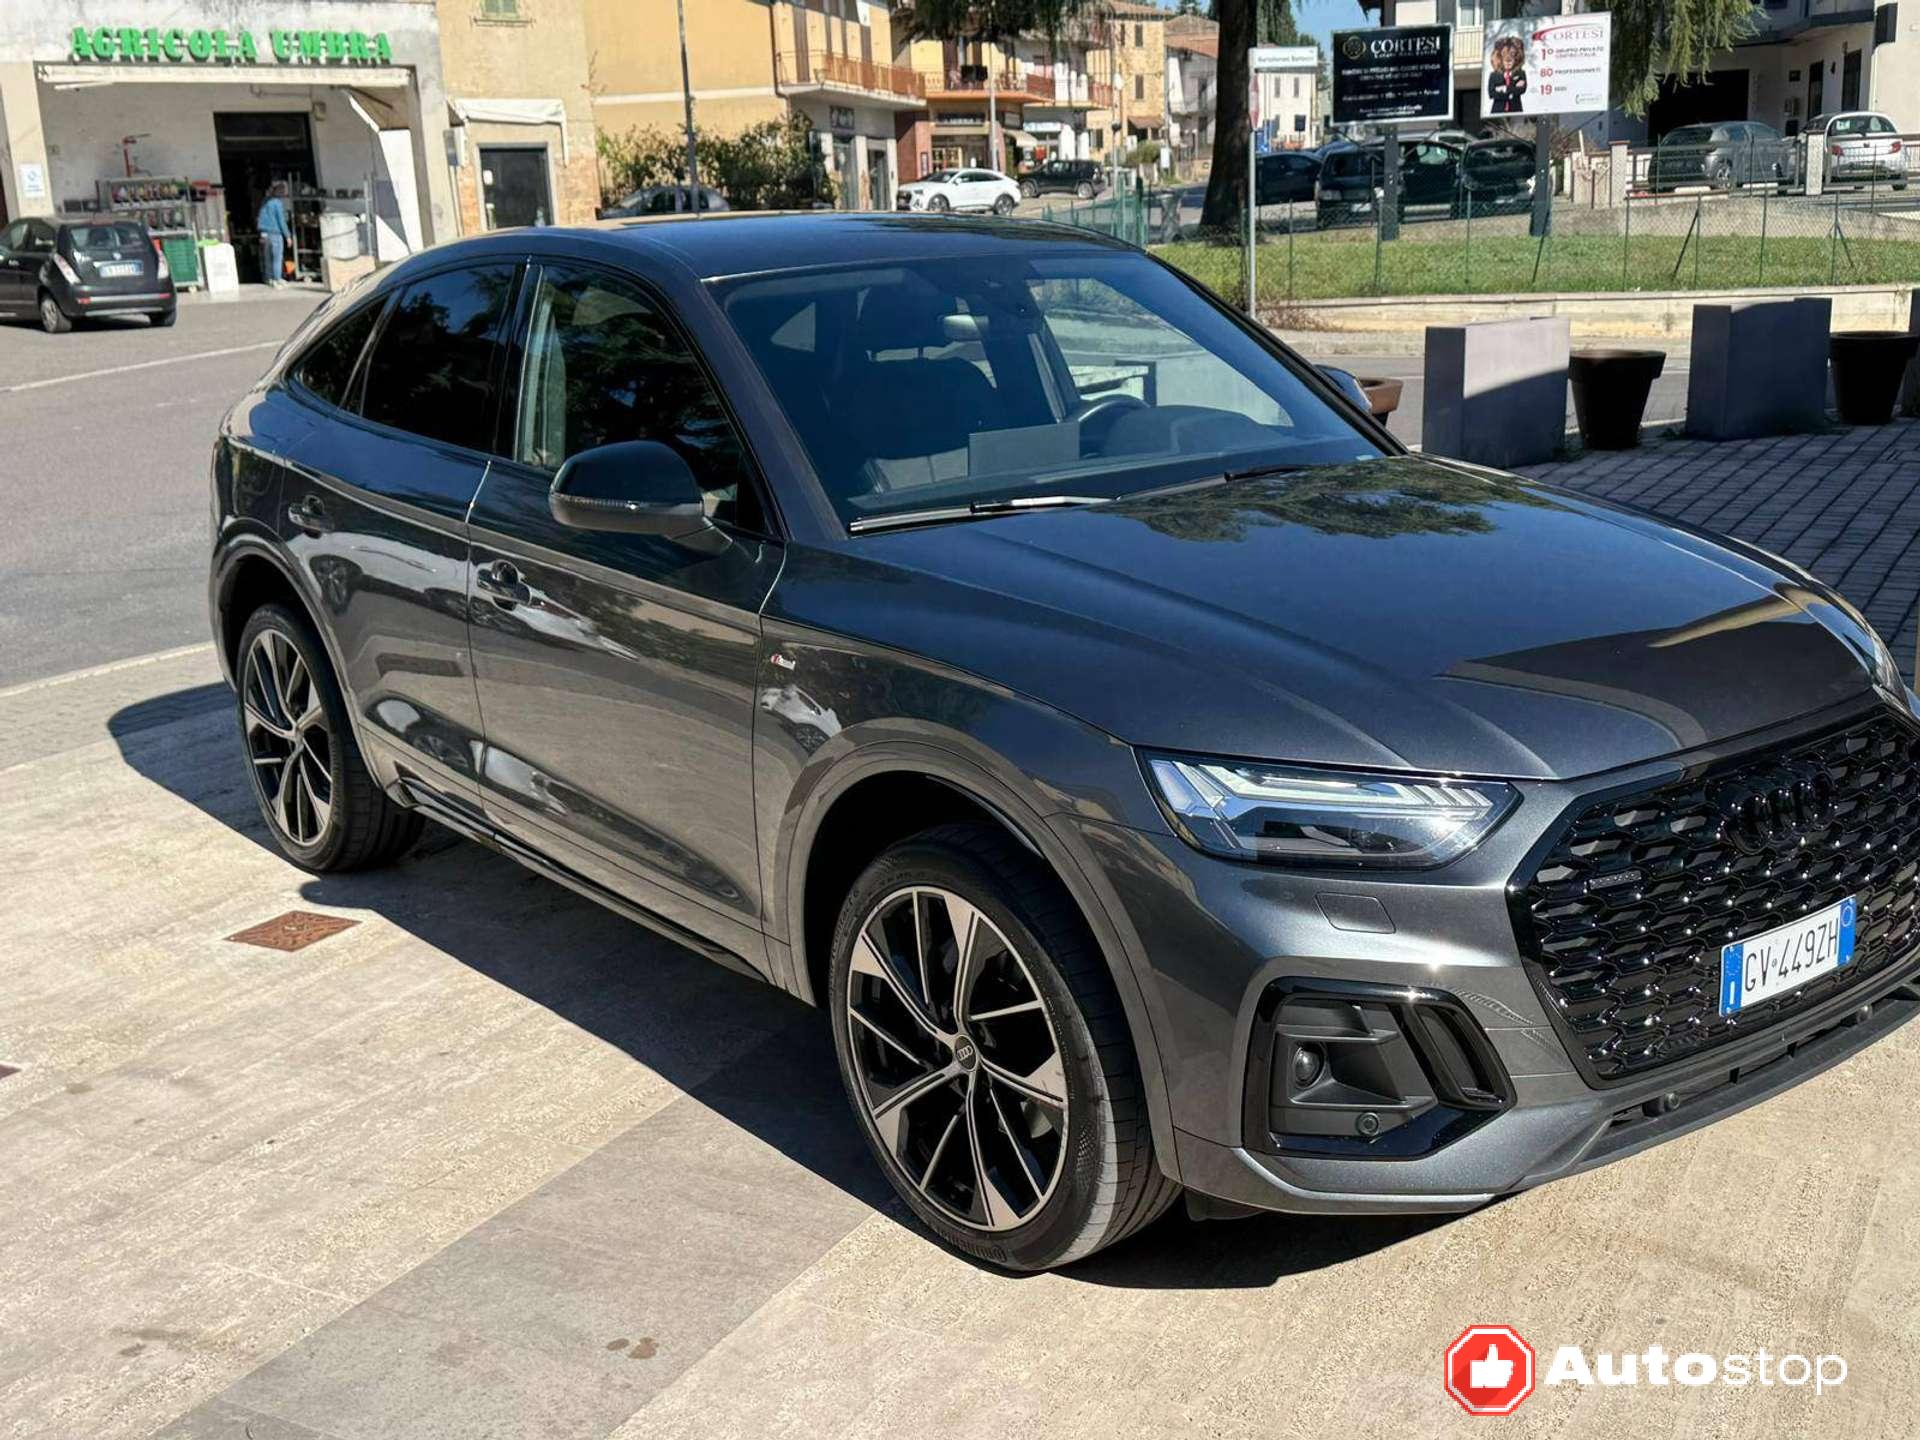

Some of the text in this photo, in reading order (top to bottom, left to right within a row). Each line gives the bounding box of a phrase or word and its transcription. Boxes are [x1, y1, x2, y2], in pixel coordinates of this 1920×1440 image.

[71, 27, 392, 62] AGRICOLA UMBRA
[1370, 36, 1441, 54] CORTESI
[1540, 84, 1553, 96] 19
[1744, 917, 1839, 992] GV 449ZH
